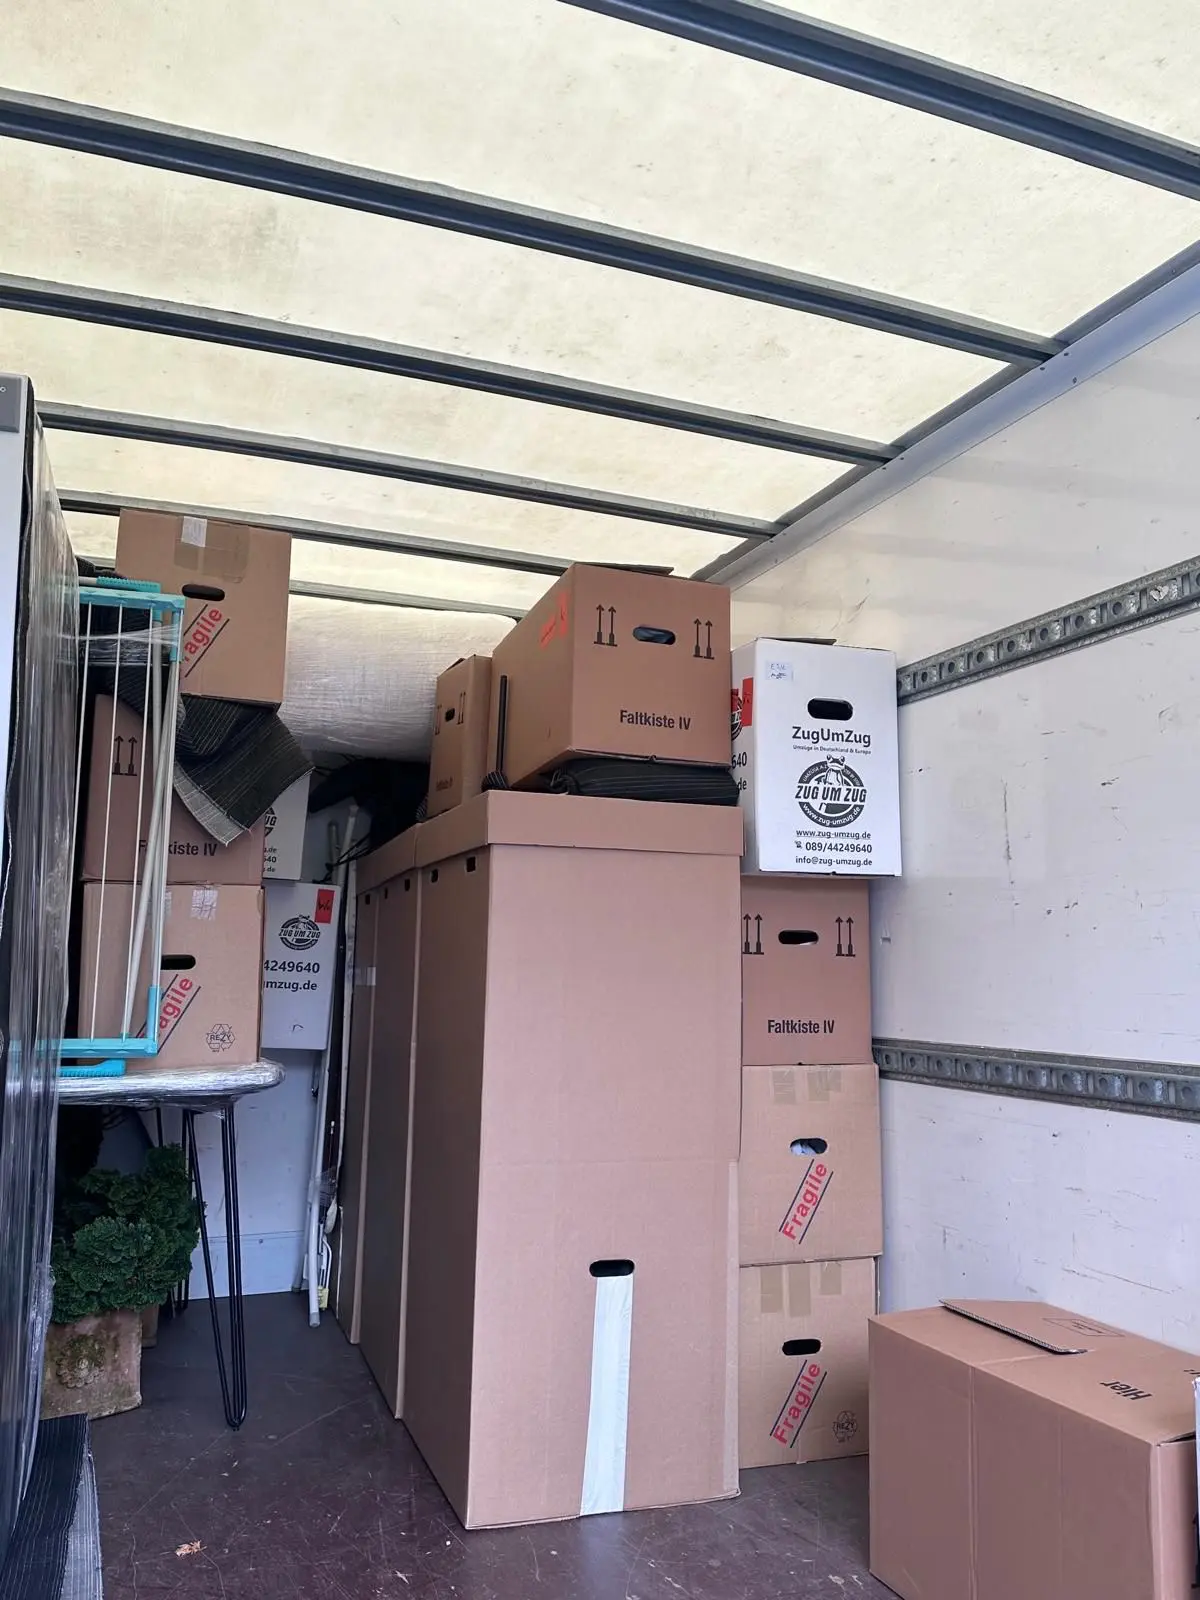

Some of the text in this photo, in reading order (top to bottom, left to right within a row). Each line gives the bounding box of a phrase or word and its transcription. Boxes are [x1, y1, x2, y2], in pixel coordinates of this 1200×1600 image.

[182, 608, 223, 663] agile
[620, 709, 691, 730] Faltkiste IV
[792, 726, 871, 747] ZugUmZug
[795, 785, 867, 803] ZUG UM ZUG
[803, 804, 861, 826] www.zug-umzug.de
[795, 830, 872, 841] www.zug-umzug.de
[139, 840, 218, 857] Fkiste IV
[805, 841, 873, 854] 089/44249640
[795, 855, 873, 868] info@zug-umzug.de
[279, 928, 321, 939] ZUG UM ZUG
[767, 1019, 835, 1034] Faltkiste IV
[209, 1033, 232, 1042] REZY
[782, 1163, 827, 1241] Fragile
[1099, 1380, 1152, 1401] Hier
[773, 1363, 821, 1445] Fragile
